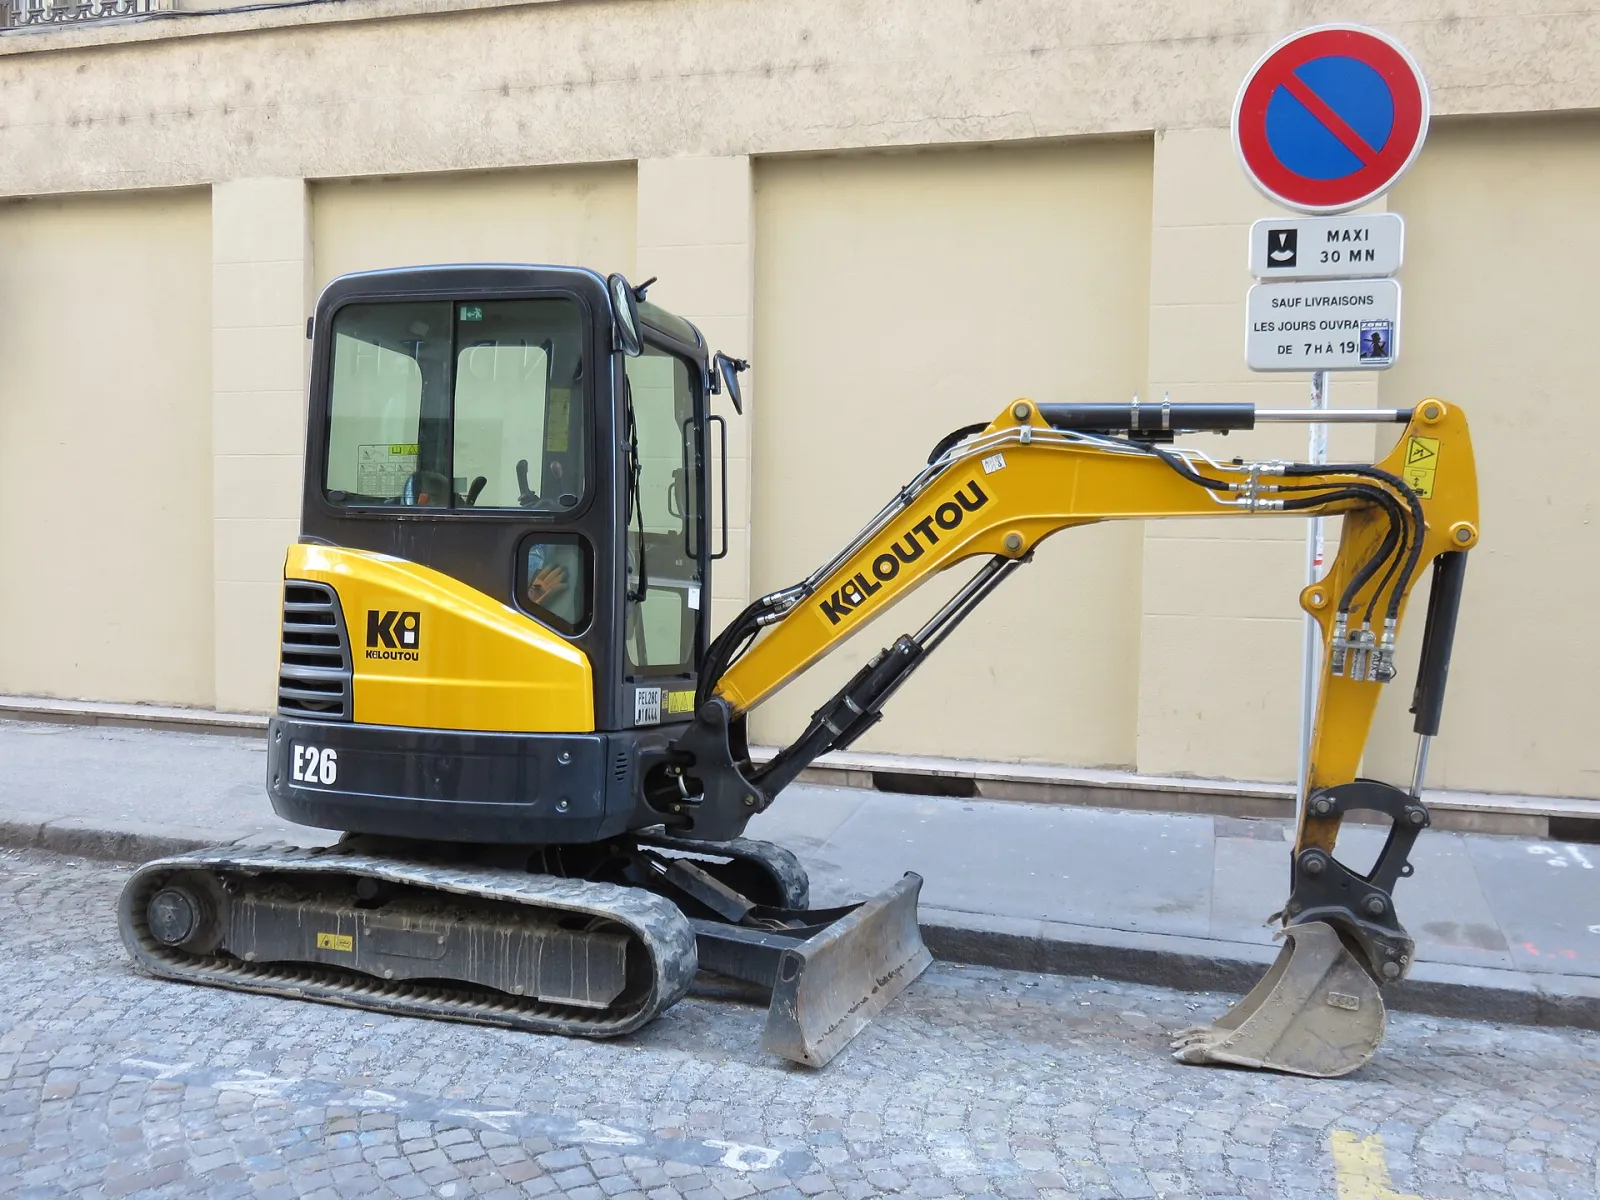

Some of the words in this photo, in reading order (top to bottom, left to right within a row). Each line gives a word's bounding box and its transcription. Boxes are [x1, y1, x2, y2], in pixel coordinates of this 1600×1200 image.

[1327, 229, 1369, 242] MAXI
[1320, 251, 1340, 263] 30
[1349, 249, 1375, 262] MN
[1271, 298, 1302, 308] SAUF
[1305, 295, 1374, 307] LIVRAISONS
[1254, 321, 1275, 332] LES
[1278, 320, 1316, 331] JOURS
[1319, 319, 1359, 330] OUVRA
[1277, 345, 1293, 355] DE
[293, 745, 337, 785] E26
